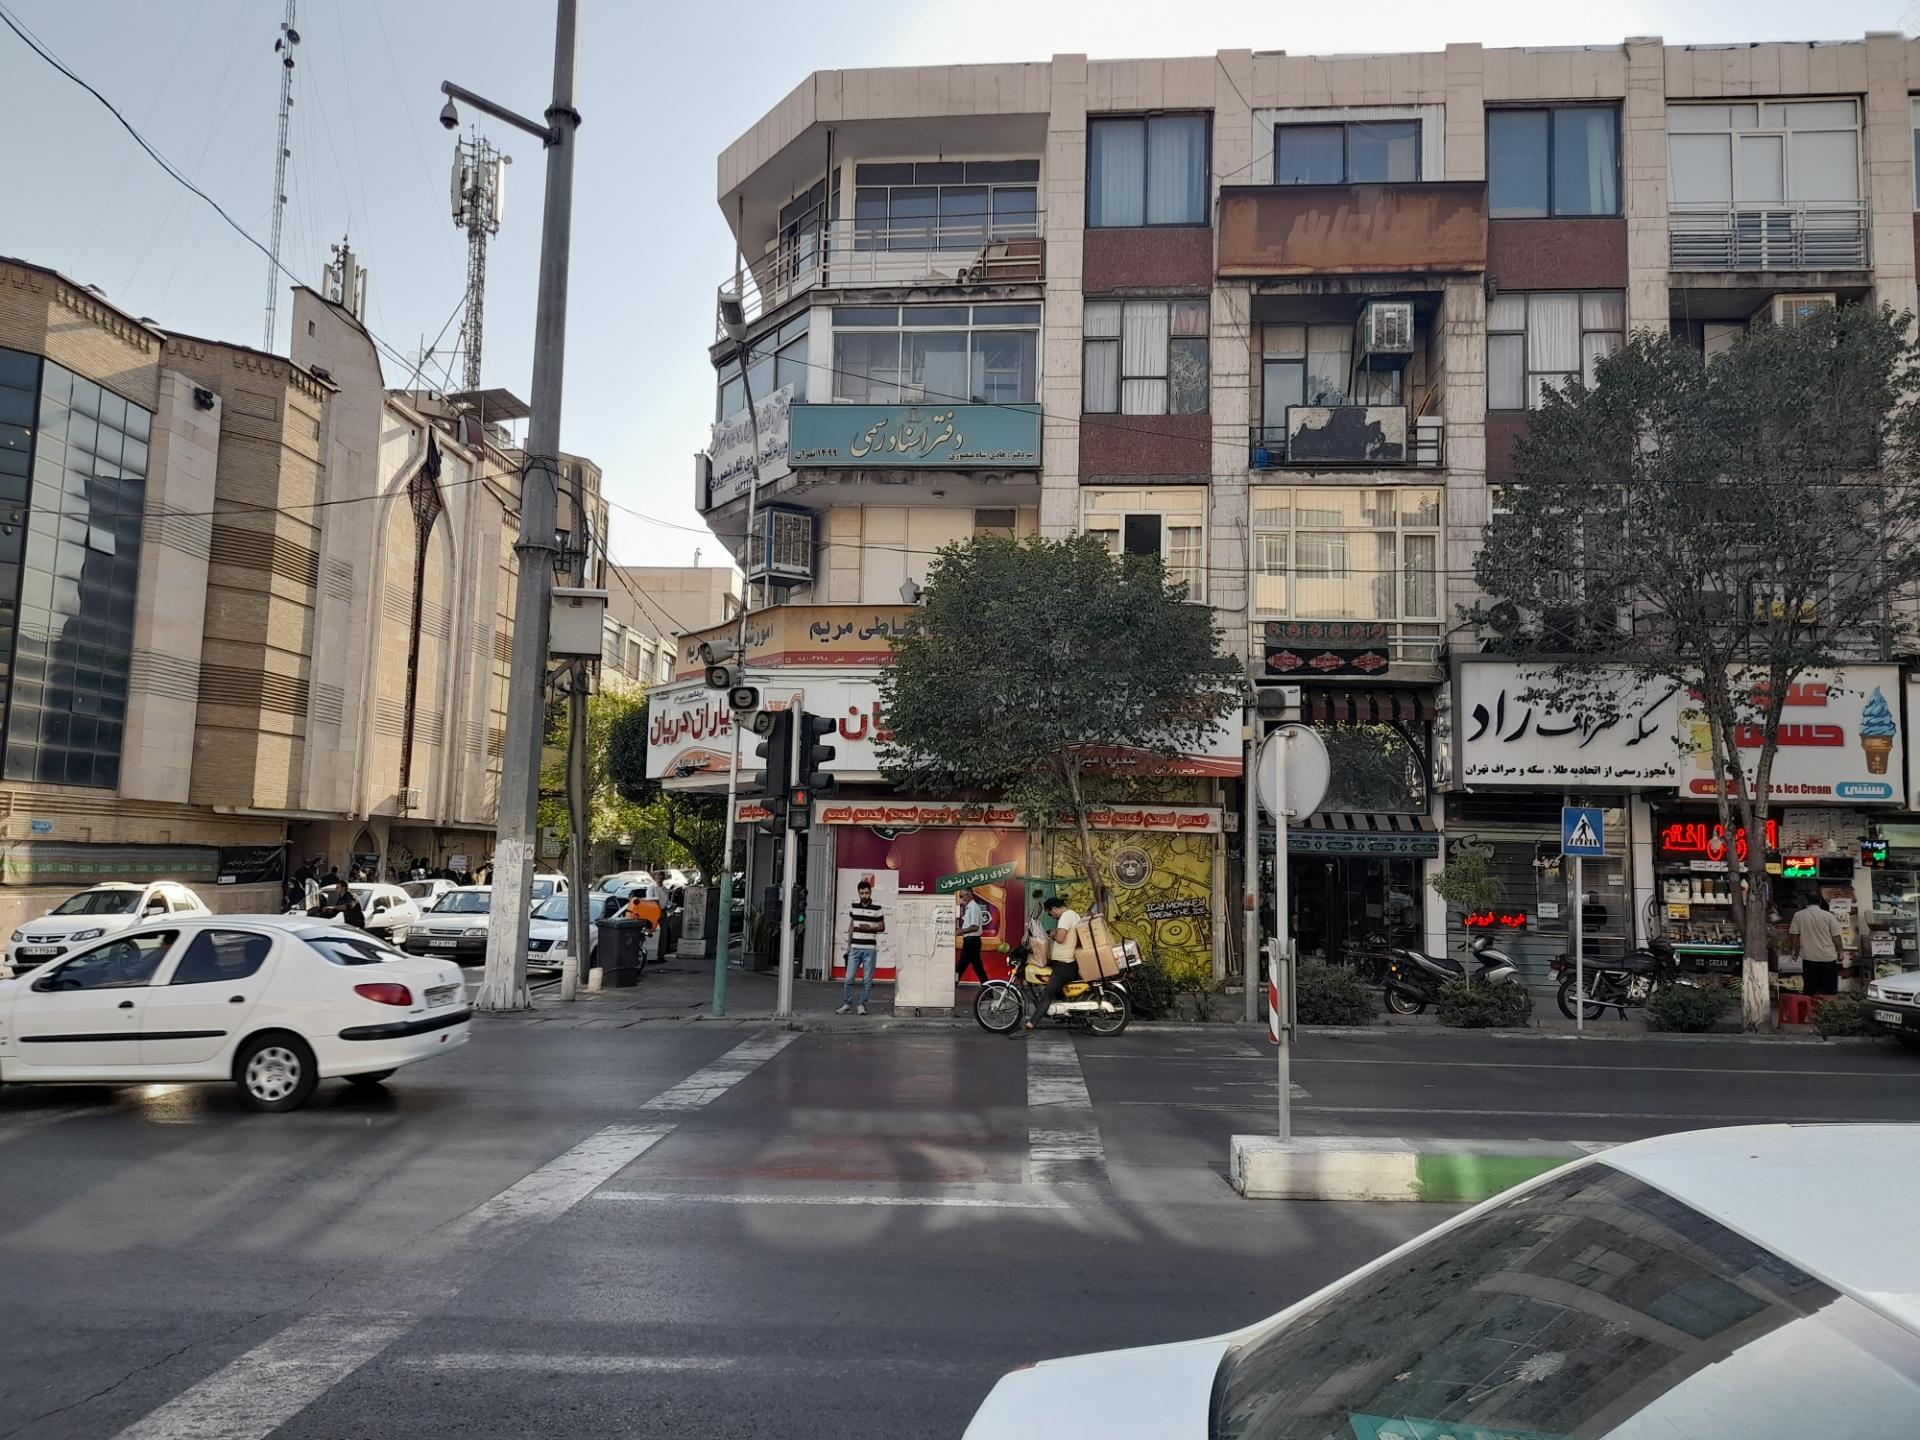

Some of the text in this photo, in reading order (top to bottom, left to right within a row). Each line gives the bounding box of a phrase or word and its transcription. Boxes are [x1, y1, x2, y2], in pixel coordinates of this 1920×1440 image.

[919, 411, 965, 459] دفتر
[809, 618, 855, 643] مریم
[1467, 689, 1532, 743] راد
[1626, 684, 1682, 747] سکه
[649, 698, 731, 746] یاران دریان
[1178, 766, 1206, 776] سرویس
[1465, 764, 1489, 776] تهران
[1491, 765, 1517, 777] صراف
[1519, 769, 1525, 777] و
[1526, 766, 1545, 775] سکه
[1569, 765, 1601, 779] اتحادیه
[1604, 766, 1613, 778] از
[1615, 766, 1641, 778] رسمی
[1776, 784, 1783, 793] &
[1784, 783, 1799, 794] Ice
[1800, 783, 1832, 795] Cream
[1844, 784, 1886, 797] بستنی
[940, 866, 1011, 890] حاوی روغن زیتون
[1145, 897, 1206, 913] ICY MONKEY
[1148, 910, 1174, 919] BREAK
[1174, 908, 1190, 917] THE
